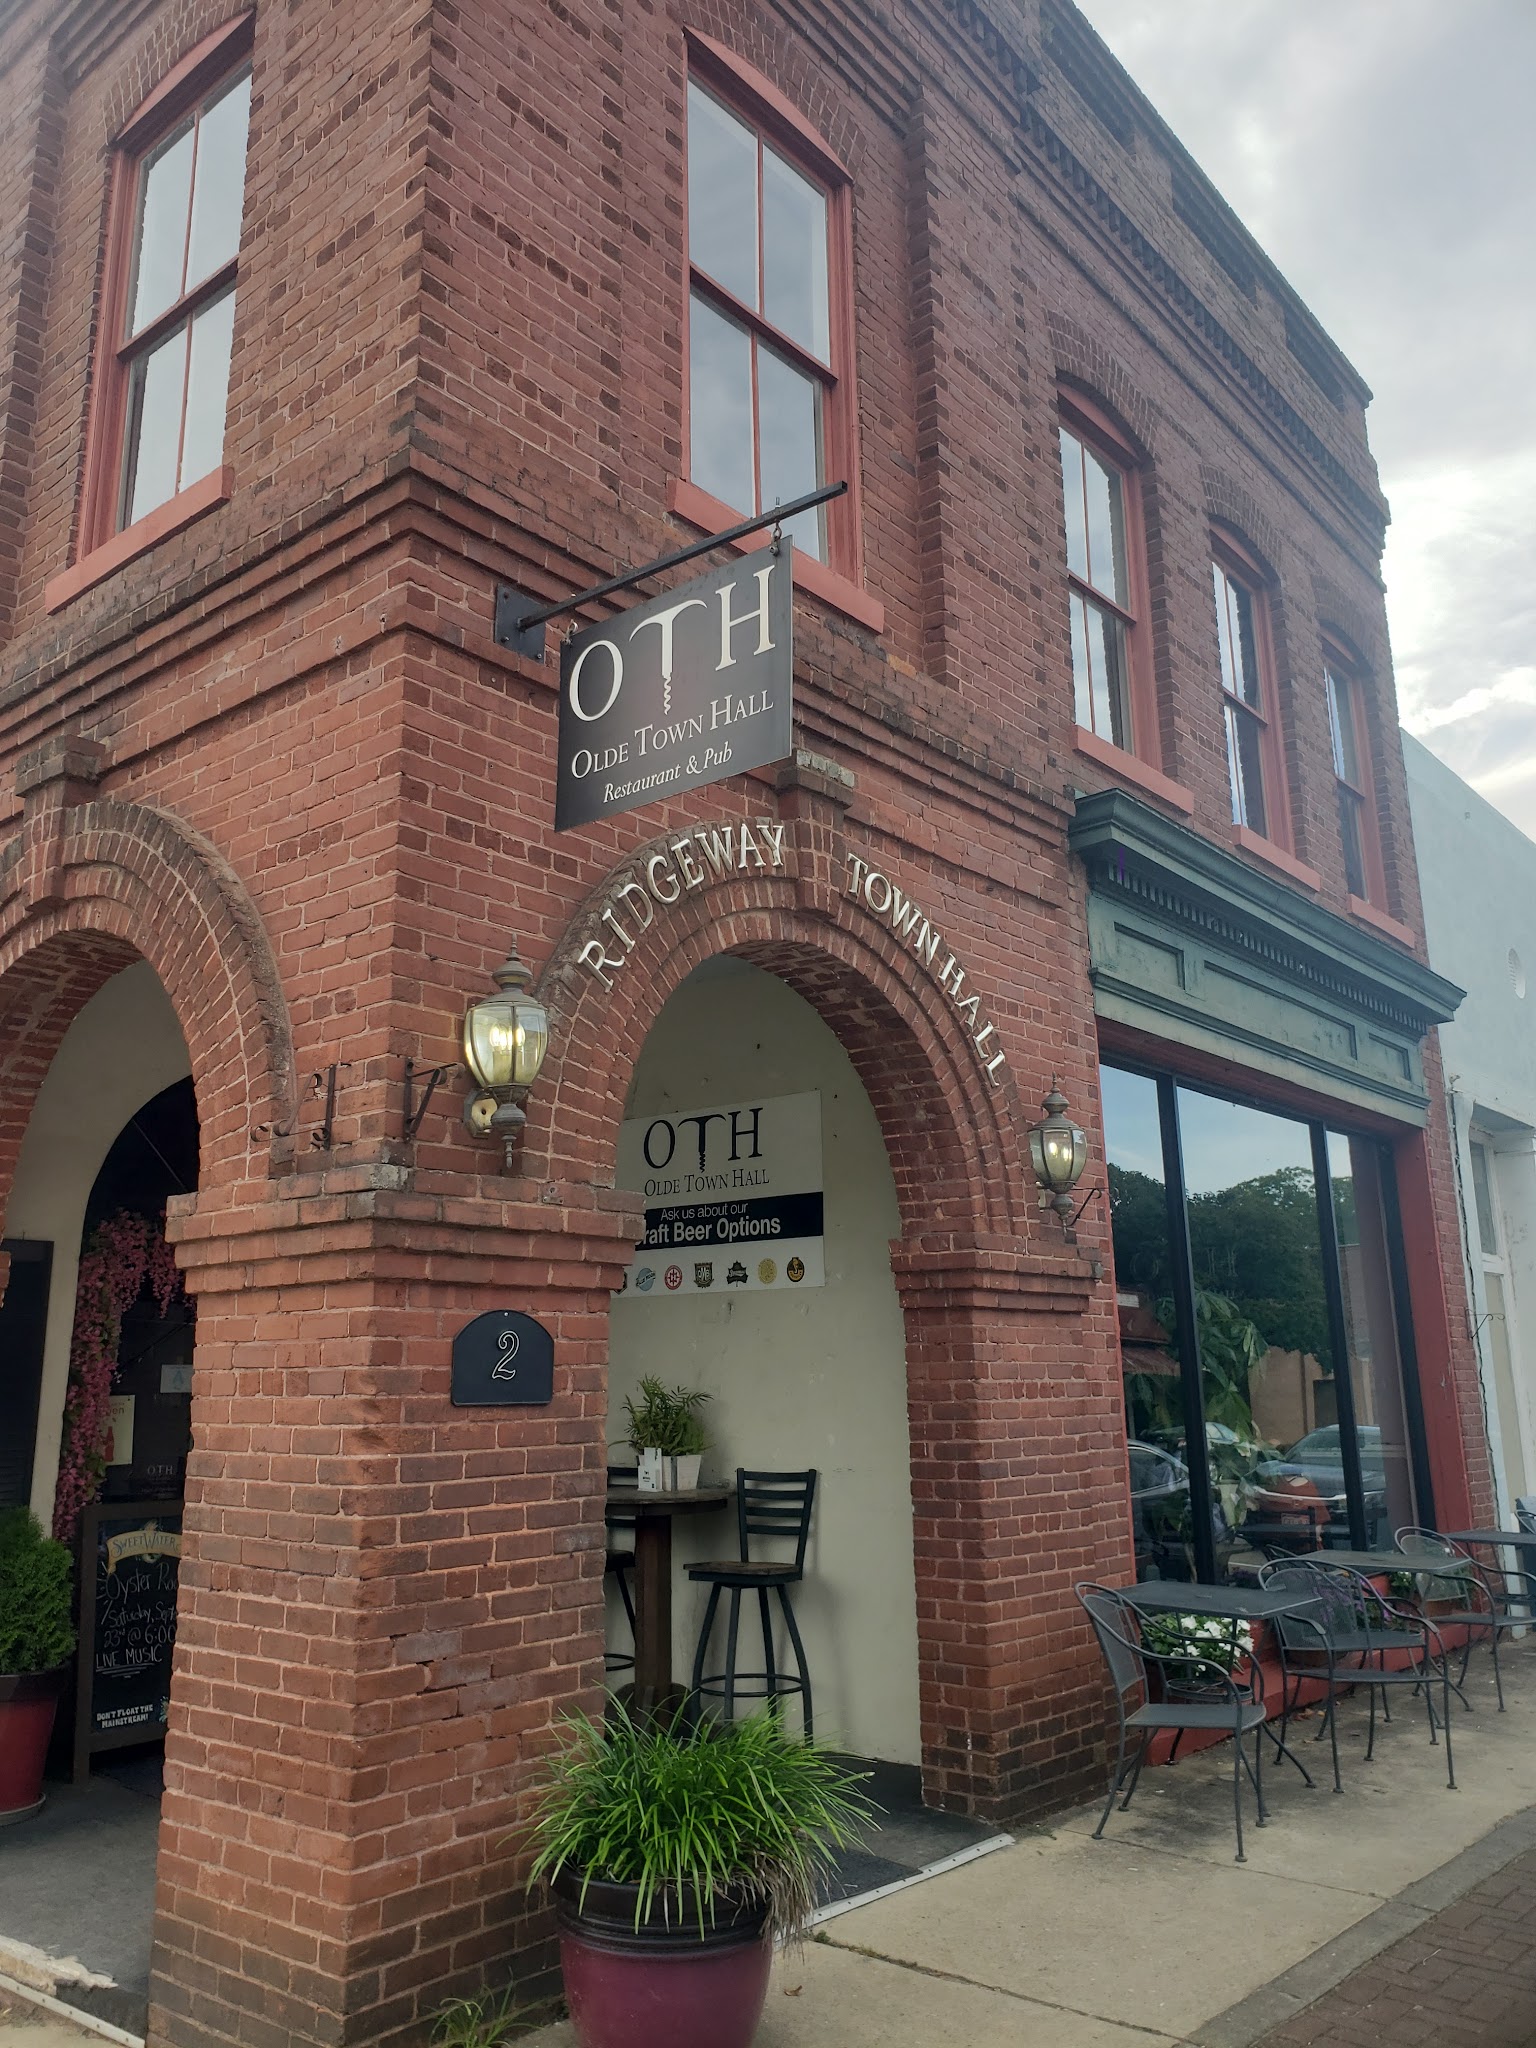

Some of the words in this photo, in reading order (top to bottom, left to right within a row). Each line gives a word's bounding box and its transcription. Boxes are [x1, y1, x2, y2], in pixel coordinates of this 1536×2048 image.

[569, 564, 776, 722] OTH
[571, 742, 629, 779] OLDE
[634, 715, 704, 757] TOWN
[709, 689, 774, 731] HALL
[603, 766, 681, 803] Restaurant
[685, 755, 703, 774] &
[703, 741, 733, 770] Pub
[578, 823, 785, 993] RIDGEWAY
[846, 852, 941, 967] TOWN
[937, 952, 1006, 1089] HALL
[643, 1107, 764, 1173] OTH
[644, 1178, 681, 1197] OLDE
[683, 1173, 729, 1193] TOWN
[731, 1169, 770, 1189] HALL
[660, 1208, 680, 1222] Ask
[681, 1208, 696, 1220] us
[697, 1202, 729, 1218] about
[730, 1202, 749, 1215] our
[638, 1222, 670, 1245] raft
[673, 1221, 712, 1243] Beer
[716, 1215, 782, 1243] Options
[491, 1330, 520, 1380] 2
[147, 1464, 173, 1476] OTH
[105, 1568, 152, 1604] Oyster
[127, 1627, 142, 1646] @
[96, 1650, 121, 1669] LIVE
[125, 1643, 163, 1665] MUSIC
[96, 1710, 117, 1721] DON'T
[116, 1706, 139, 1718] FLOAT
[140, 1703, 154, 1713] THE
[101, 1713, 149, 1729] MAINSTREAM!
